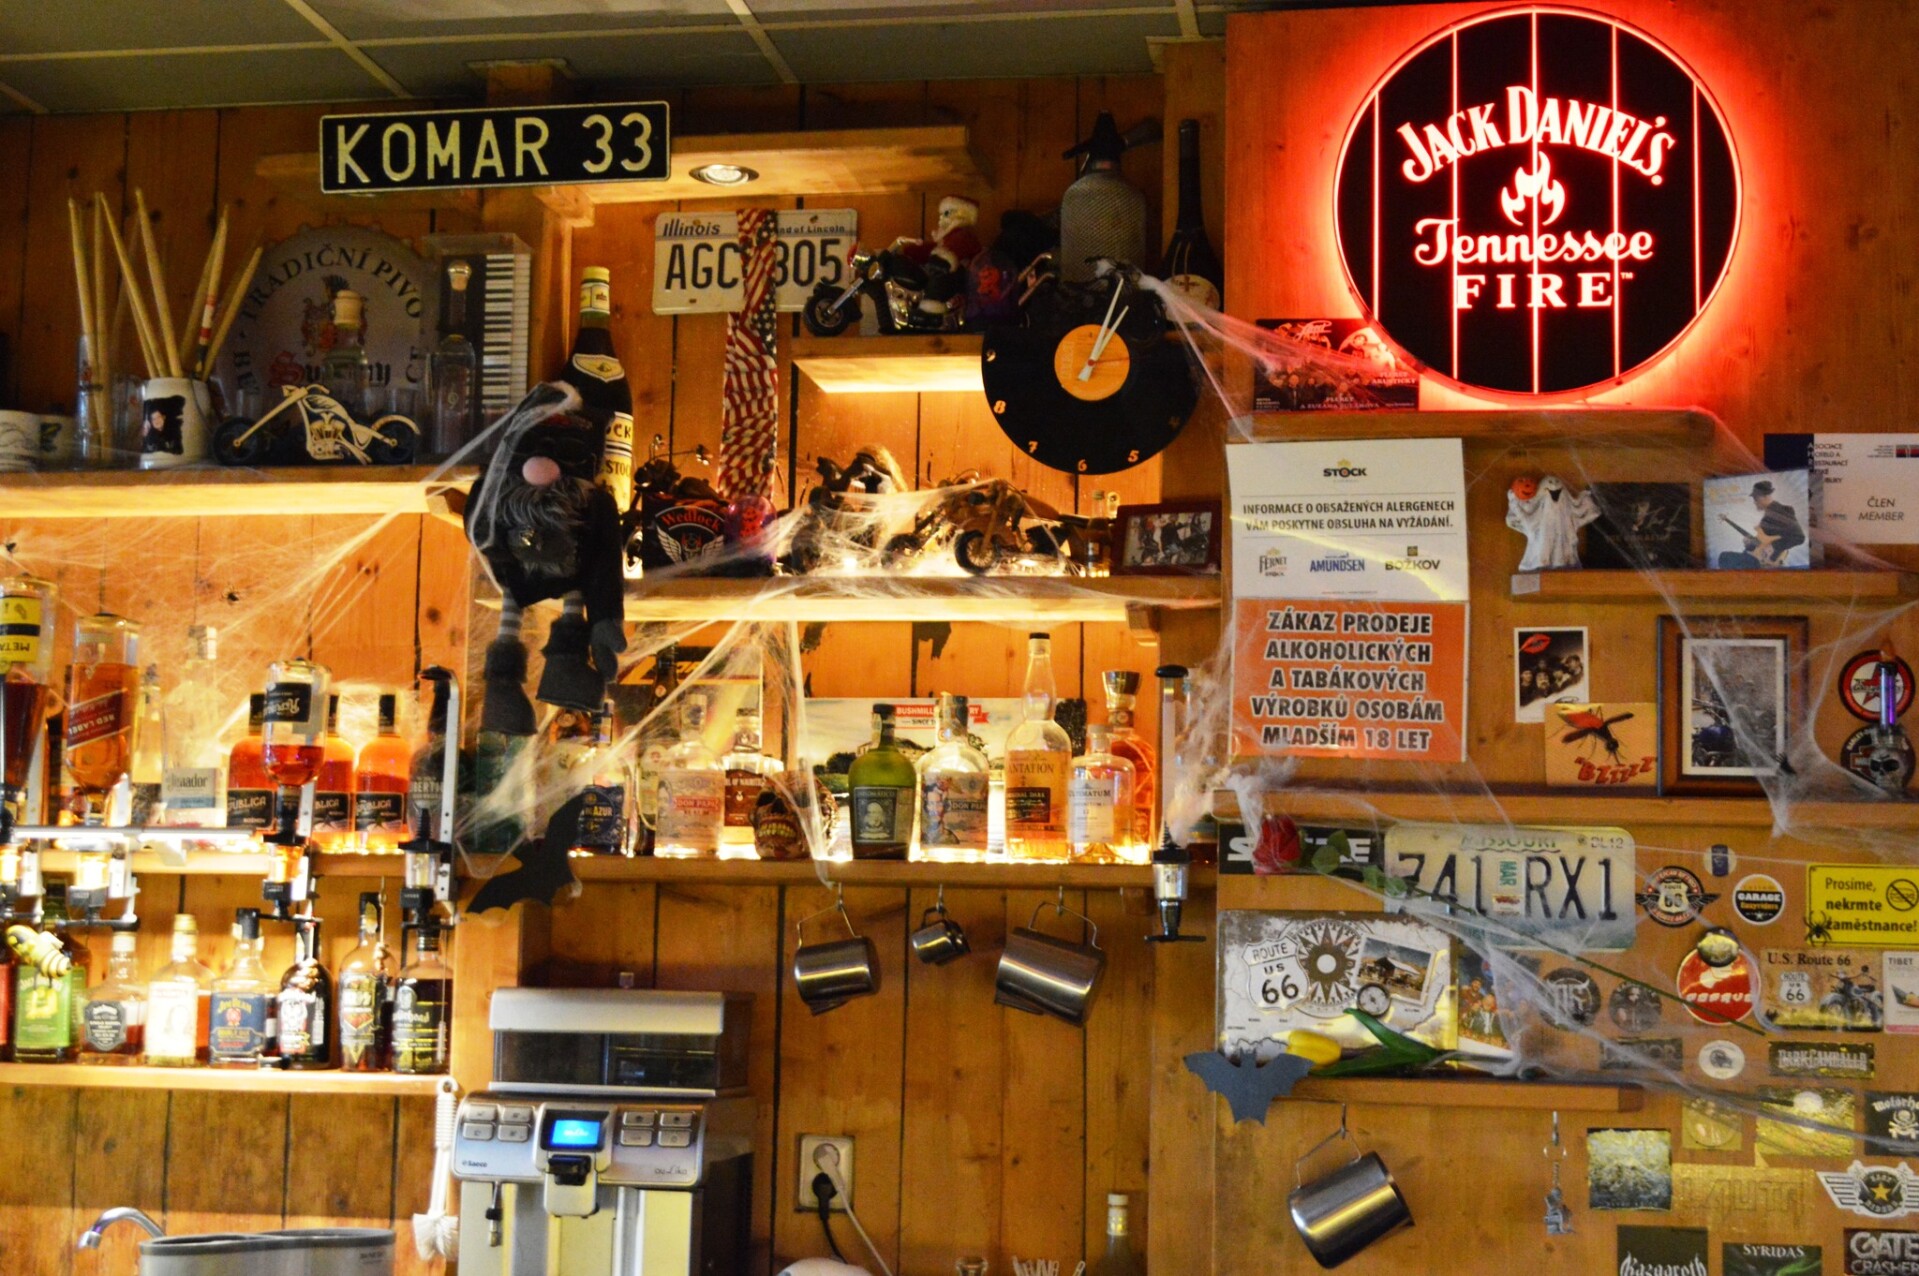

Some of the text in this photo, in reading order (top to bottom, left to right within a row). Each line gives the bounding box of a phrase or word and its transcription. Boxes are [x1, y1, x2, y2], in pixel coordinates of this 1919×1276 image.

[1397, 85, 1676, 186] JACK DANIEL'S
[336, 111, 652, 184] KOMAR 33
[663, 219, 721, 237] Illinois
[807, 225, 845, 234] Lincoln
[1414, 217, 1654, 266] Tennessee
[665, 242, 740, 290] AGC
[372, 257, 424, 320] PIVO
[1456, 272, 1613, 310] FIRE
[993, 399, 1007, 414] 8
[1027, 440, 1039, 455] 7
[1128, 449, 1140, 463] 5
[1077, 459, 1088, 472] 6
[1322, 467, 1367, 478] STOCK
[1243, 500, 1455, 515] INFORMACE O OBSAŽENÝCH ALERGENECH
[1867, 496, 1896, 508] ČLEN
[1271, 518, 1324, 531] POSKYTNE
[1327, 518, 1377, 530] OBSLUHA
[1379, 518, 1395, 529] NA
[1858, 512, 1905, 521] MEMBER
[1259, 555, 1288, 573] FERNET
[1310, 559, 1366, 572] AMUNDSEN
[1267, 605, 1432, 634] ZÁKAZ PRODEJE
[1264, 638, 1432, 664] ALKOHOLICKÝCH
[1270, 665, 1425, 692] A TABÁKOVÝCH
[896, 706, 934, 715] BUSHMILL
[1251, 693, 1444, 722] VÝROBKŮ OSOBÁM
[1365, 730, 1391, 749] 18
[1397, 731, 1430, 750] LET
[1525, 855, 1618, 920] RX1
[1737, 893, 1781, 902] GARAGE
[1826, 896, 1883, 912] nekrmte
[1252, 942, 1289, 962] ROUTE
[1768, 951, 1851, 966] U.S. Route 66
[1888, 957, 1914, 966] TIBET
[1261, 974, 1300, 1005] 66
[1786, 989, 1806, 1001] 66
